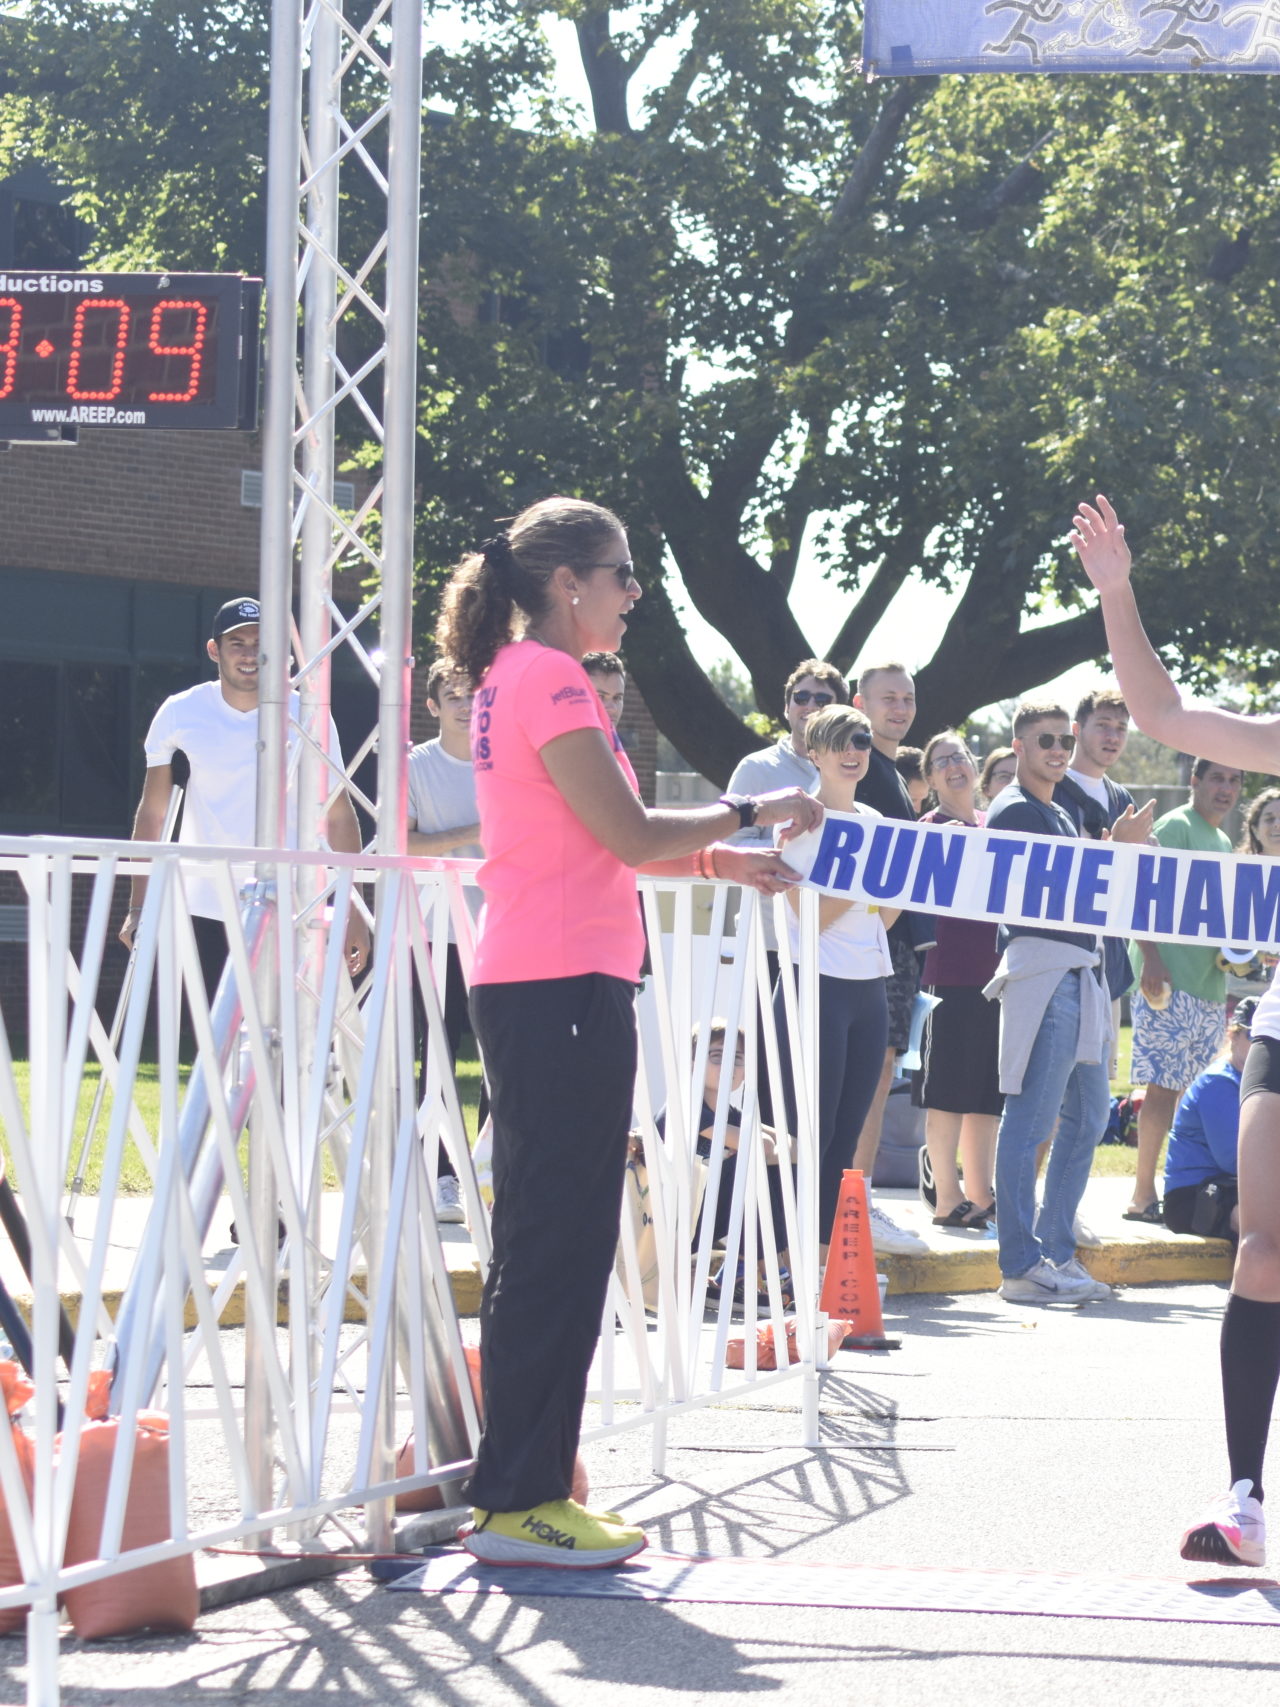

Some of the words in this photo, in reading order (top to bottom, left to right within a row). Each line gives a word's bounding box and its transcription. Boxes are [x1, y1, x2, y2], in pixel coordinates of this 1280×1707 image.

[32, 406, 146, 424] www.AREEP.com
[550, 686, 587, 705] jetBlue
[809, 818, 967, 909] RUN
[985, 838, 1114, 927] THE
[521, 1515, 576, 1550] HOKA
